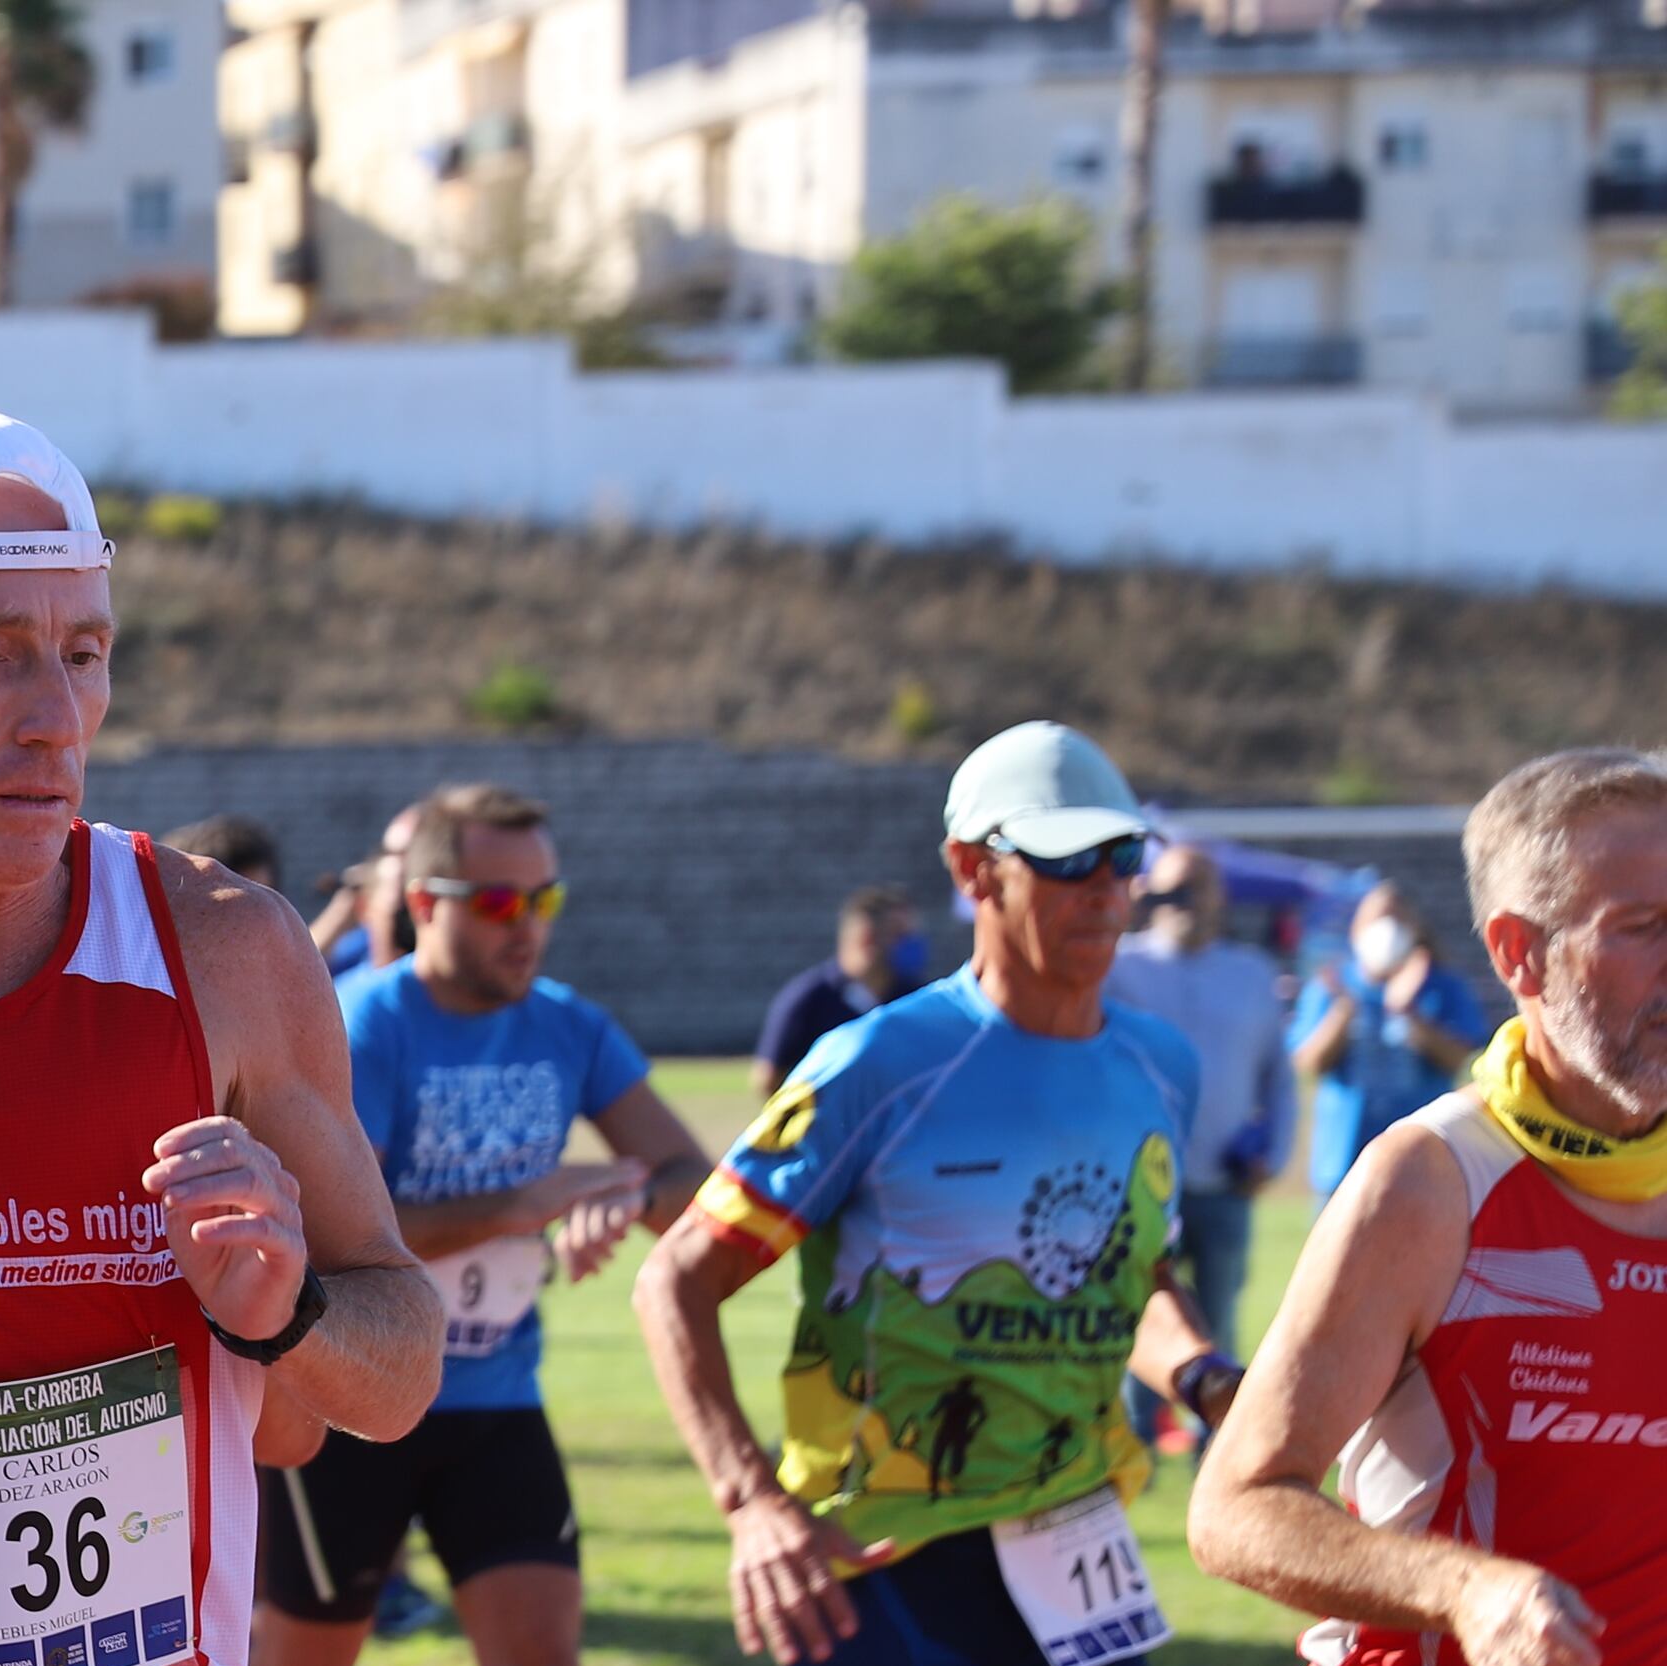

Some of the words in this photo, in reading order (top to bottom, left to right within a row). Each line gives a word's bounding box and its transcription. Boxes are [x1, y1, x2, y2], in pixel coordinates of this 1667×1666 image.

[0, 544, 68, 556] BOOMERANG
[0, 1256, 95, 1284] medina
[1509, 1340, 1593, 1368] Atletismo
[1509, 1366, 1589, 1394] Chiclana
[66, 1412, 97, 1441] DEL
[99, 1391, 168, 1433] AUTISMO
[3, 1443, 100, 1481] CARLOS
[40, 1466, 111, 1498] ARAGON
[50, 1607, 96, 1634] MIGUEL
